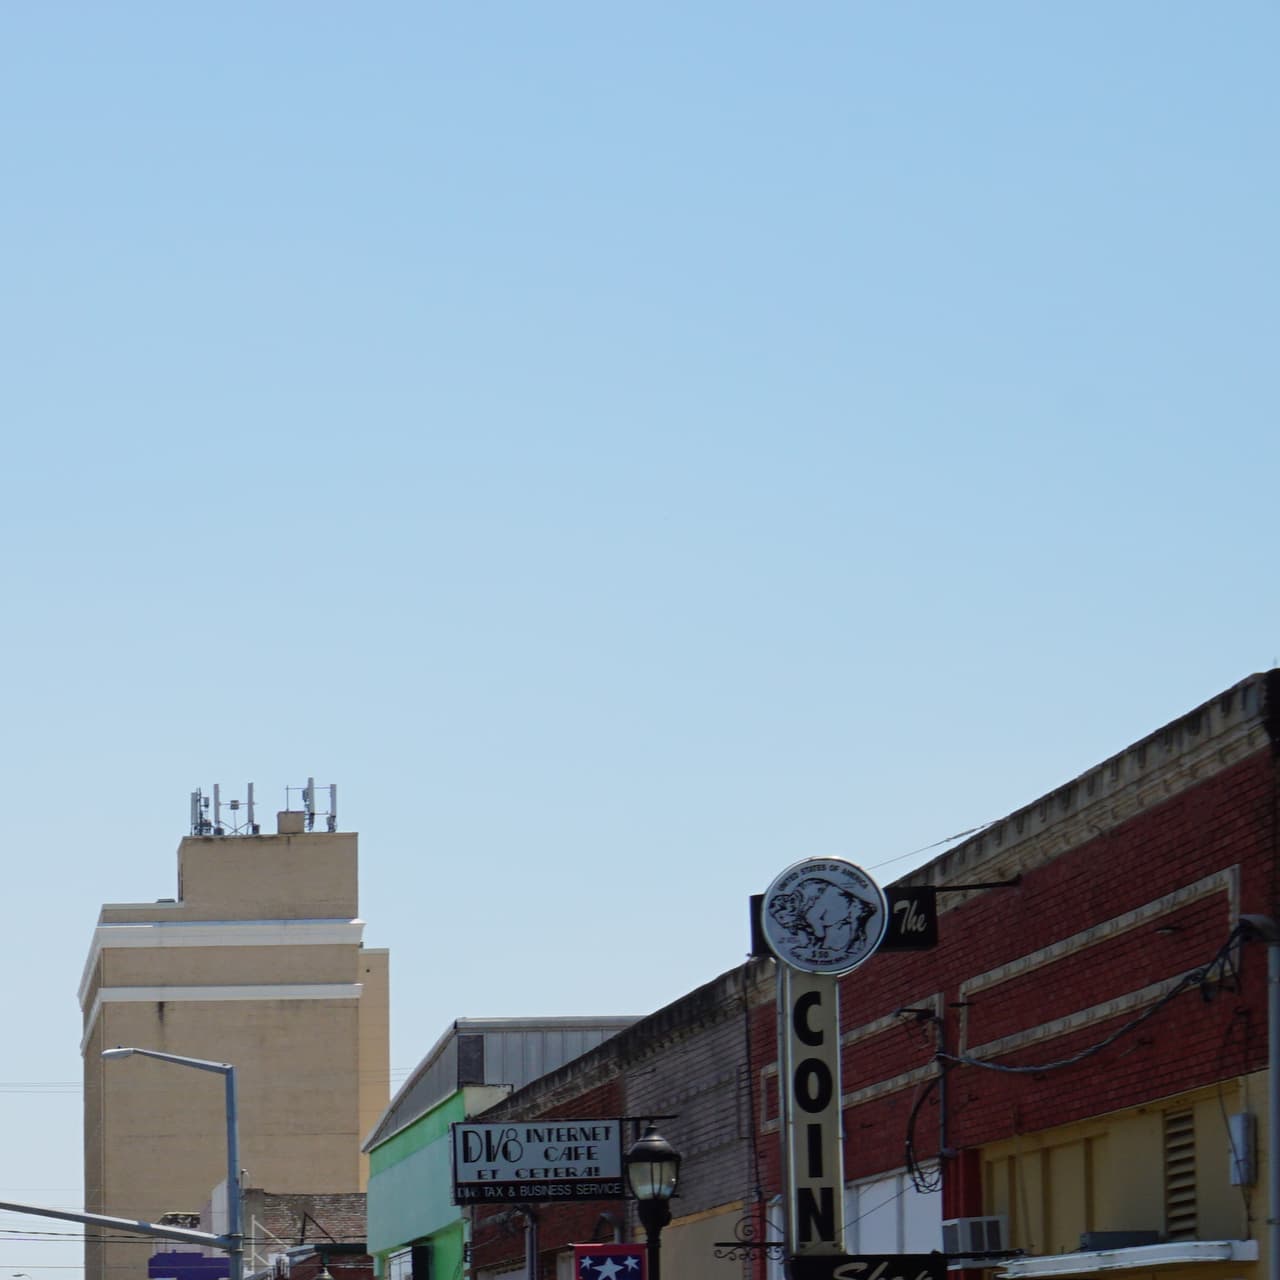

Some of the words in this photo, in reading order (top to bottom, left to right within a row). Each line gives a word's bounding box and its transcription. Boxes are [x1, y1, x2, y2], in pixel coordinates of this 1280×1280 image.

[800, 864, 828, 877] STATES
[829, 864, 840, 872] OF
[842, 868, 869, 891] AMERICA
[894, 900, 927, 934] The
[793, 990, 834, 1242] COIN
[526, 1126, 612, 1143] INTERNET
[543, 1145, 600, 1162] CAFE
[477, 1169, 500, 1180] ET
[484, 1186, 504, 1198] TAX
[508, 1187, 516, 1197] &
[520, 1184, 571, 1197] BUSINESS
[576, 1182, 622, 1196] SERVICE
